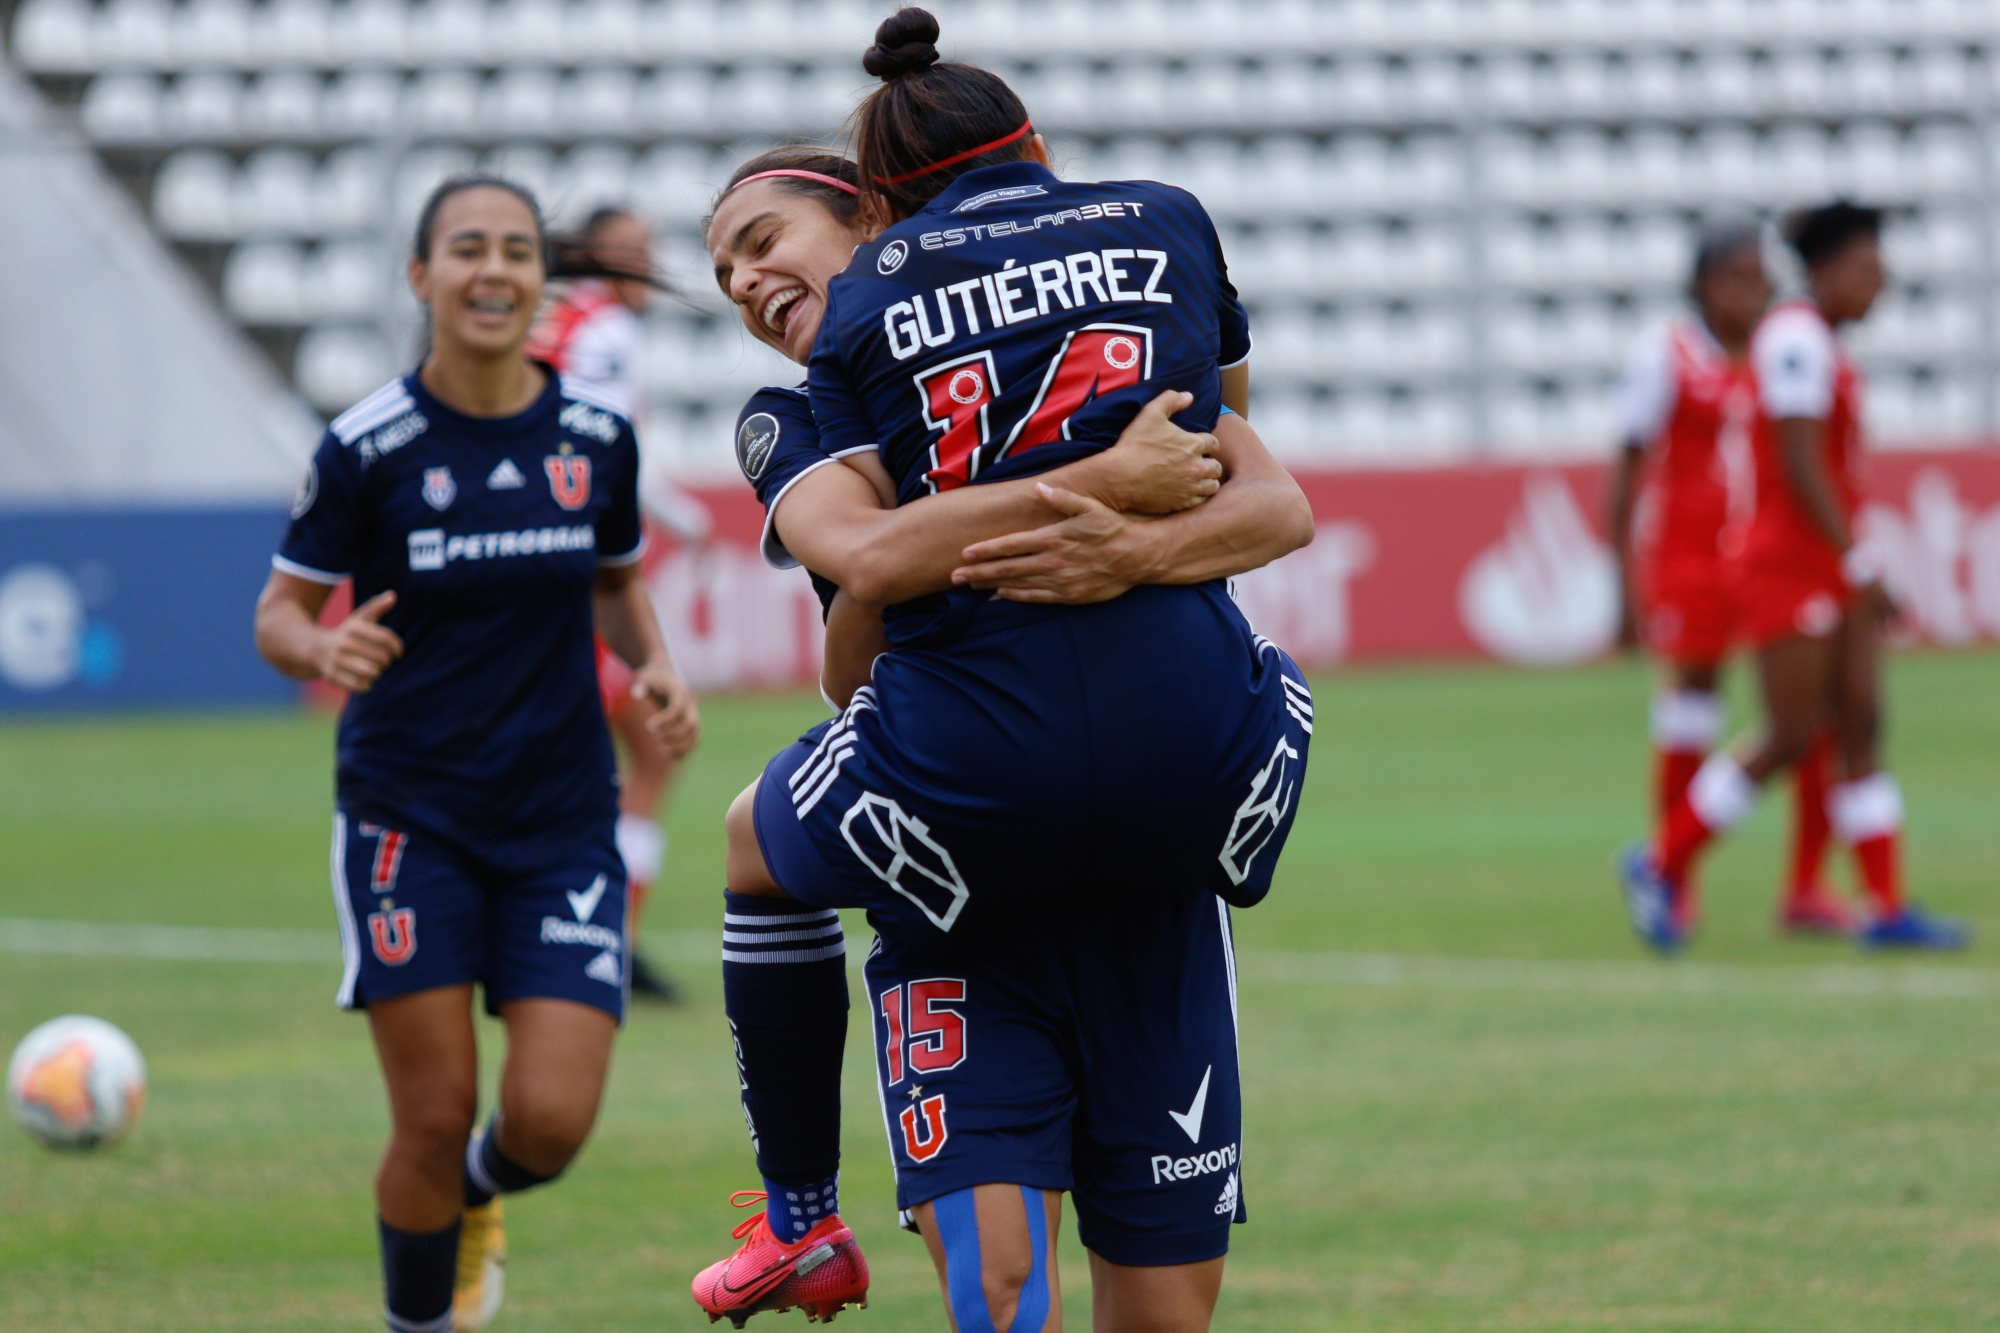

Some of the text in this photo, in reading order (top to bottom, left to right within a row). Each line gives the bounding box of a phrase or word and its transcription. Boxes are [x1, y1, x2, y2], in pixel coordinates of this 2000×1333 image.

[998, 188, 1026, 198] Viajero
[919, 202, 1143, 251] ESTELARBET
[883, 249, 1172, 360] GUTIÉRREZ
[543, 454, 592, 511] U
[359, 820, 408, 893] 7
[367, 907, 417, 967] U
[880, 978, 967, 1087] 15
[900, 1094, 949, 1164] U
[1151, 1142, 1237, 1185] Rexona
